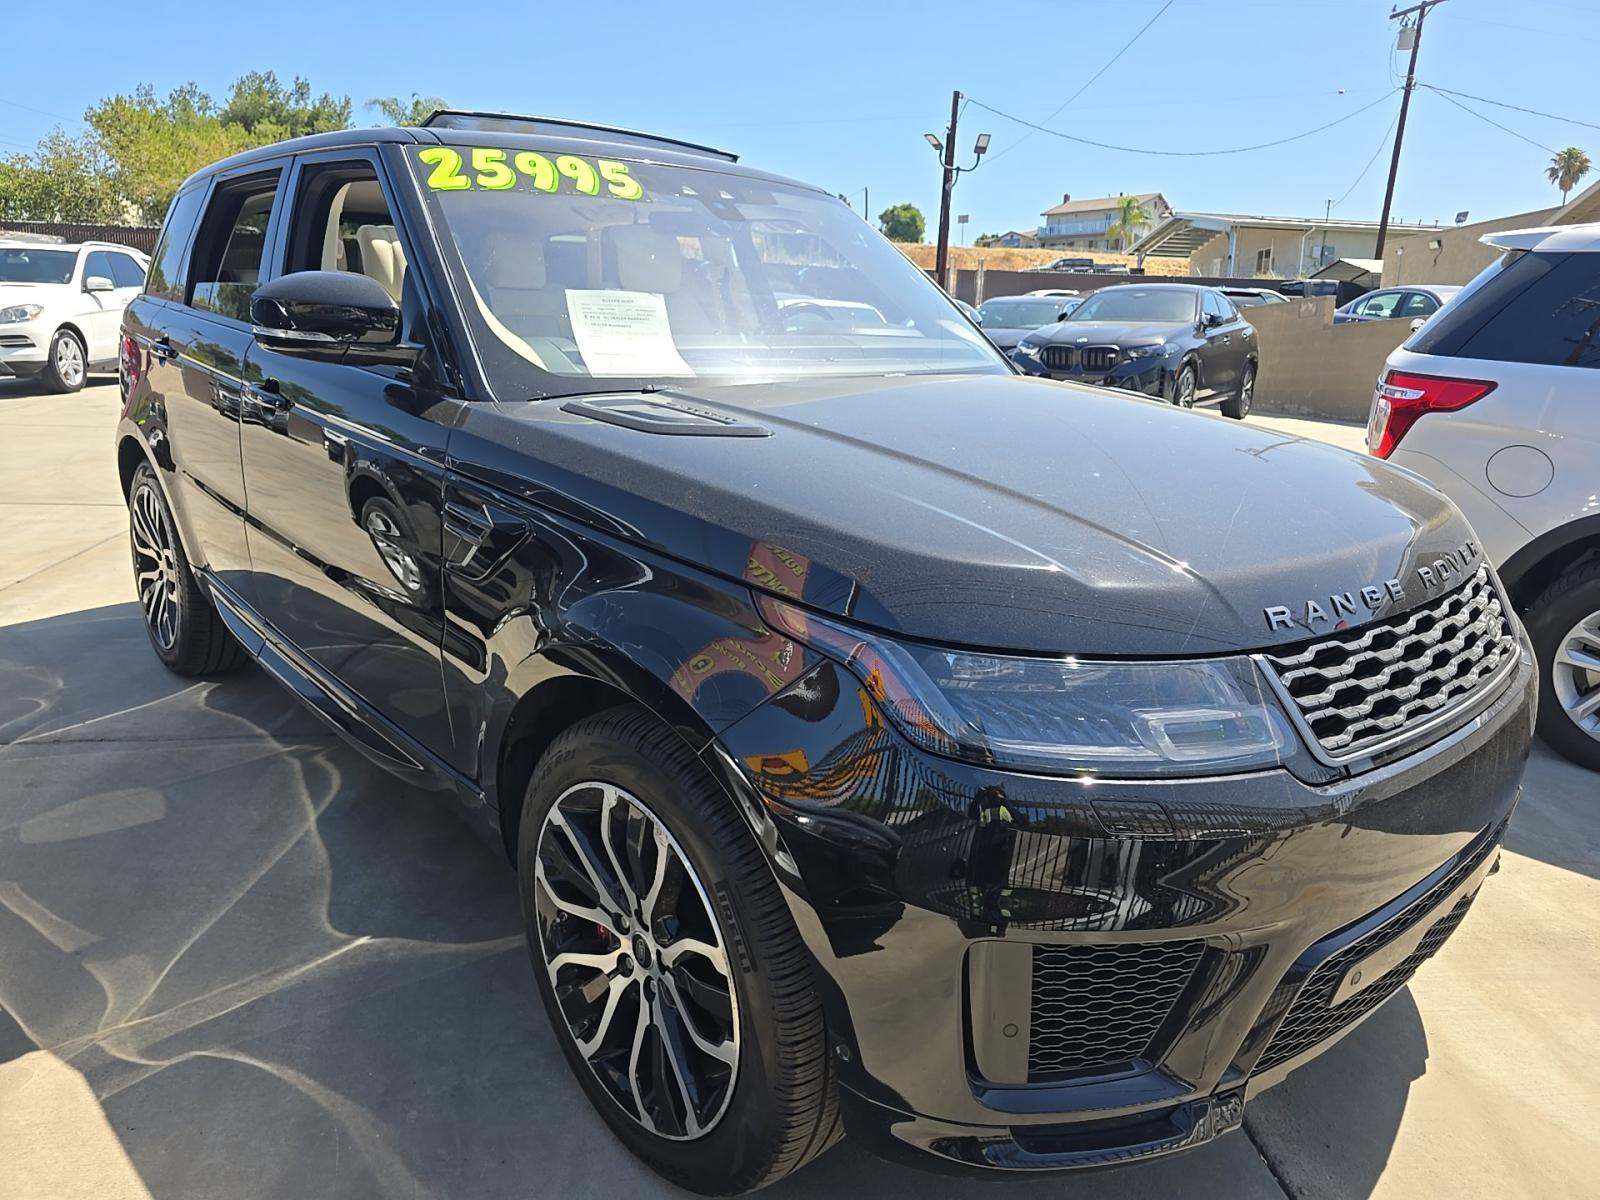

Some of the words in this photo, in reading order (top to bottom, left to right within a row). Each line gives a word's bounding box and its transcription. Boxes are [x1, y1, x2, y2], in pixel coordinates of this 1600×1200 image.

[418, 147, 643, 200] 25995
[1264, 578, 1405, 631] RANGE
[1417, 540, 1479, 590] ROVER
